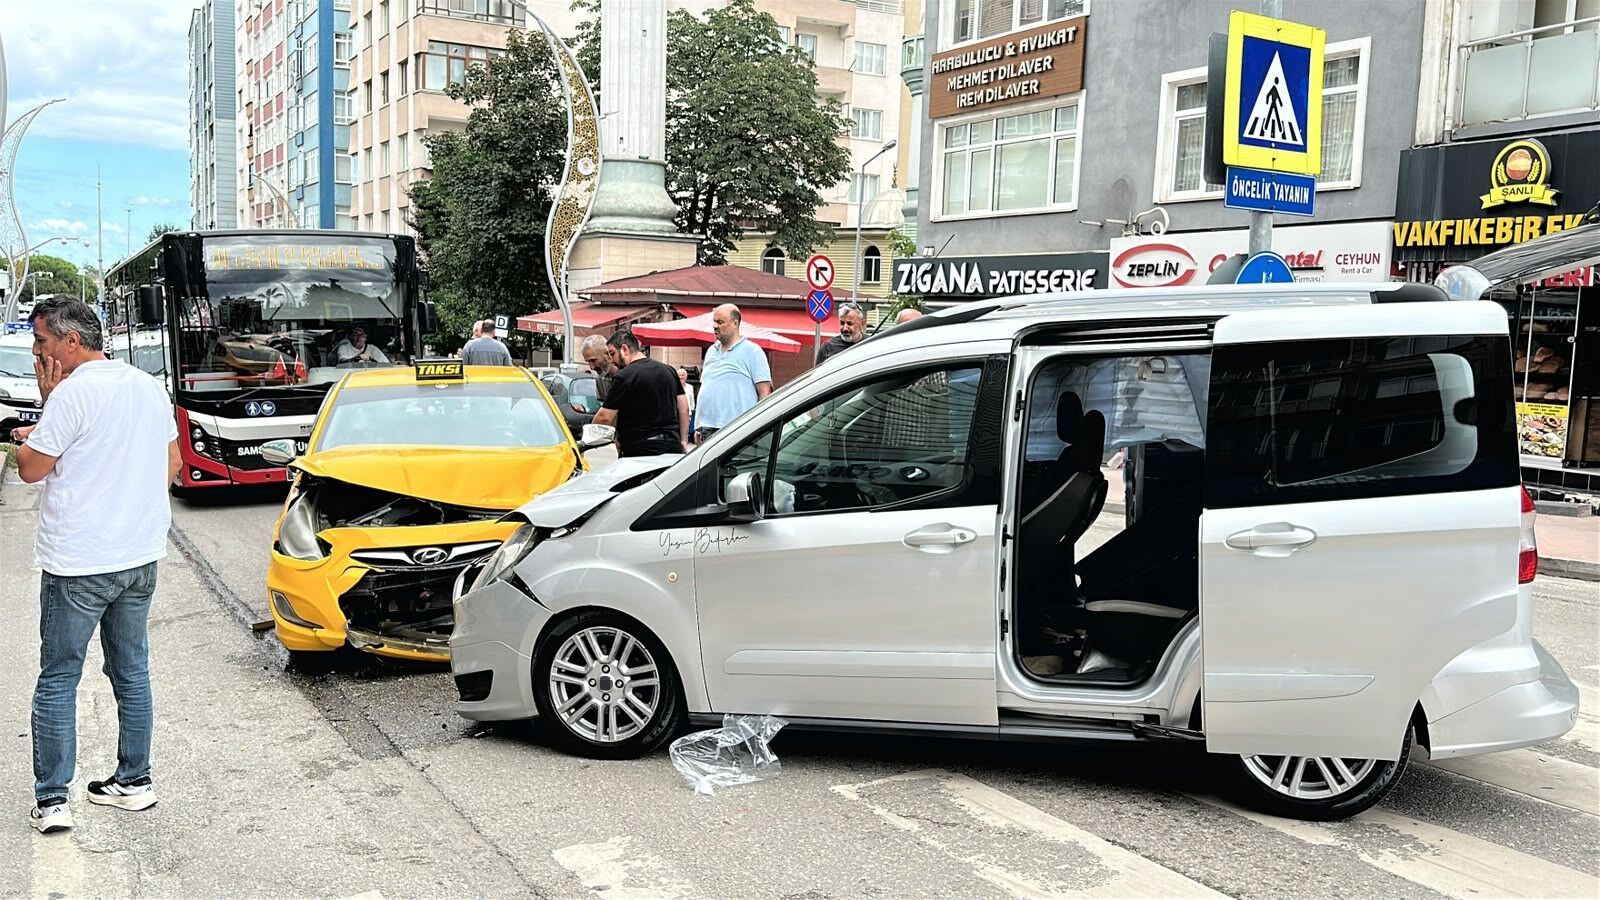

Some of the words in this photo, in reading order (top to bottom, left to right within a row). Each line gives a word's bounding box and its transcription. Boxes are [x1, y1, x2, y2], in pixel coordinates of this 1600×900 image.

[931, 45, 1003, 75] ARABULUCU
[1005, 41, 1017, 57] &
[1019, 26, 1078, 53] AVUKAT
[946, 69, 998, 92] MEHMET
[1232, 175, 1271, 200] ÖNCELİK
[1272, 182, 1310, 205] YAYANIN
[1501, 186, 1534, 198] ŞANLI
[1335, 252, 1381, 266] CEYHUN
[1127, 260, 1180, 277] ZEPLİN
[1341, 267, 1354, 275] Rent
[897, 261, 985, 294] ZIGANA
[989, 268, 1097, 294] PATISSERIE
[497, 317, 506, 327] D
